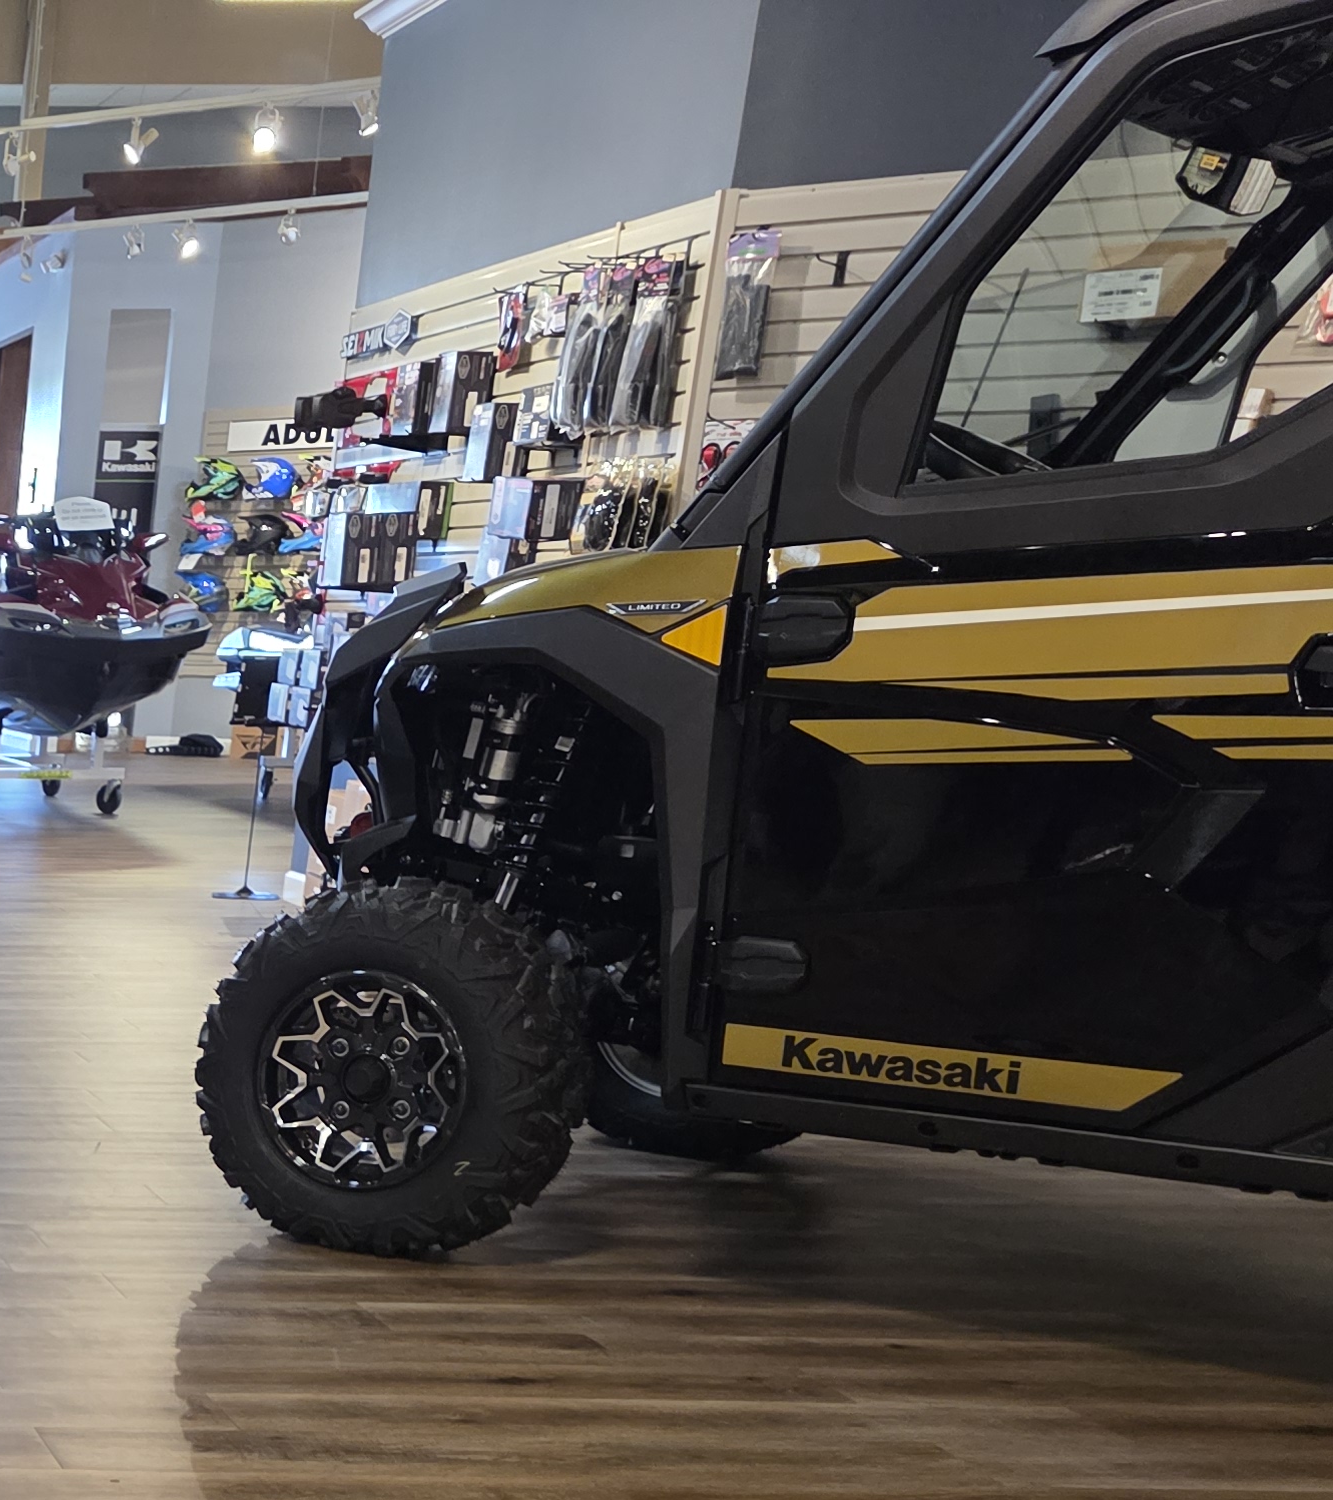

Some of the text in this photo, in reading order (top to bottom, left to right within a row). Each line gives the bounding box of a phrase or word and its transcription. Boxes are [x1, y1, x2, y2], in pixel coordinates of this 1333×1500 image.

[261, 424, 335, 446] ADUL
[101, 461, 156, 472] Kawasaki
[628, 603, 681, 611] LIMITED
[782, 1035, 1022, 1095] Kawasaki
